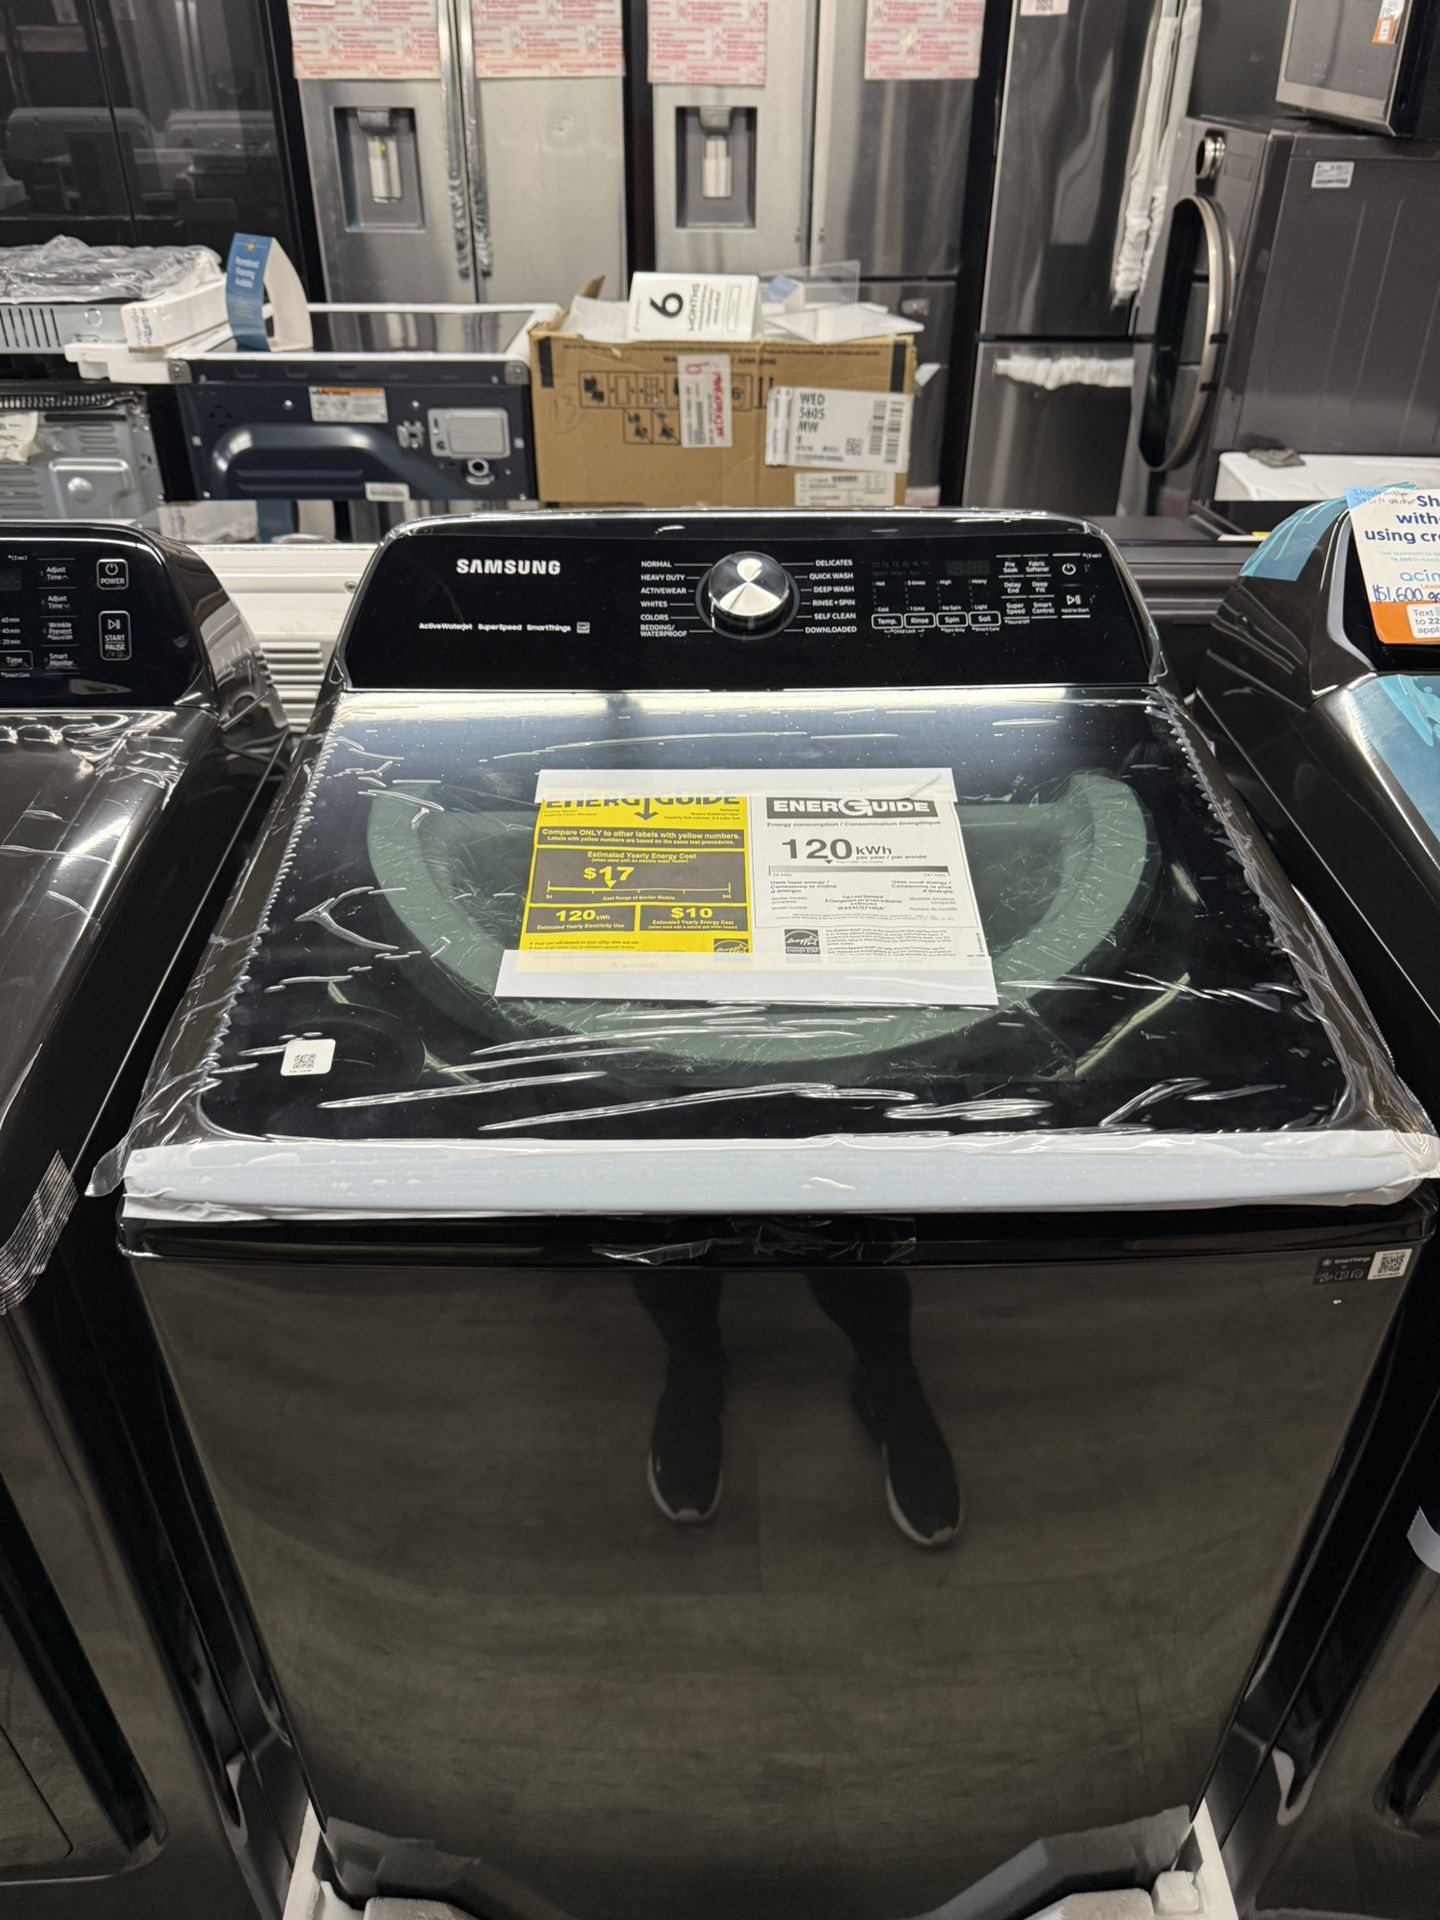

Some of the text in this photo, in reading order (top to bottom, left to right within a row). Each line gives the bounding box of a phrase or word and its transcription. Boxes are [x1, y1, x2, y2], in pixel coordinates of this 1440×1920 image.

[649, 292, 684, 318] 6
[799, 392, 825, 405] WED
[798, 421, 819, 433] MW
[1396, 512, 1440, 524] with
[1364, 528, 1416, 544] using
[456, 558, 561, 575] SAMSUNG
[641, 560, 672, 568] NORMAL
[815, 558, 853, 567] DELICATES
[46, 566, 66, 574] Adjust
[641, 573, 686, 581] HEAVY DUTY
[809, 572, 854, 580] QUICK WASH
[100, 577, 125, 585] POWER
[48, 595, 67, 603] Adjust
[641, 600, 668, 608] WHITES
[640, 613, 669, 621] COLORS
[814, 612, 856, 620] SELF CLEAN
[944, 616, 960, 624] Spin
[877, 617, 897, 625] Temp.
[527, 623, 572, 633] SmartThings
[805, 625, 857, 634] DOWNLOADED
[640, 630, 688, 638] WATERPROOF
[542, 828, 577, 837] Compare
[603, 829, 612, 837] to
[635, 830, 658, 838] labels
[660, 831, 676, 839] with
[678, 832, 703, 841] yellow
[704, 832, 741, 840] numbers.
[782, 838, 892, 860] 120 kWh
[587, 851, 625, 859] Estimated
[626, 852, 649, 860] Yearly
[583, 866, 634, 881] $17
[556, 909, 597, 922] 120
[670, 907, 713, 920] $10
